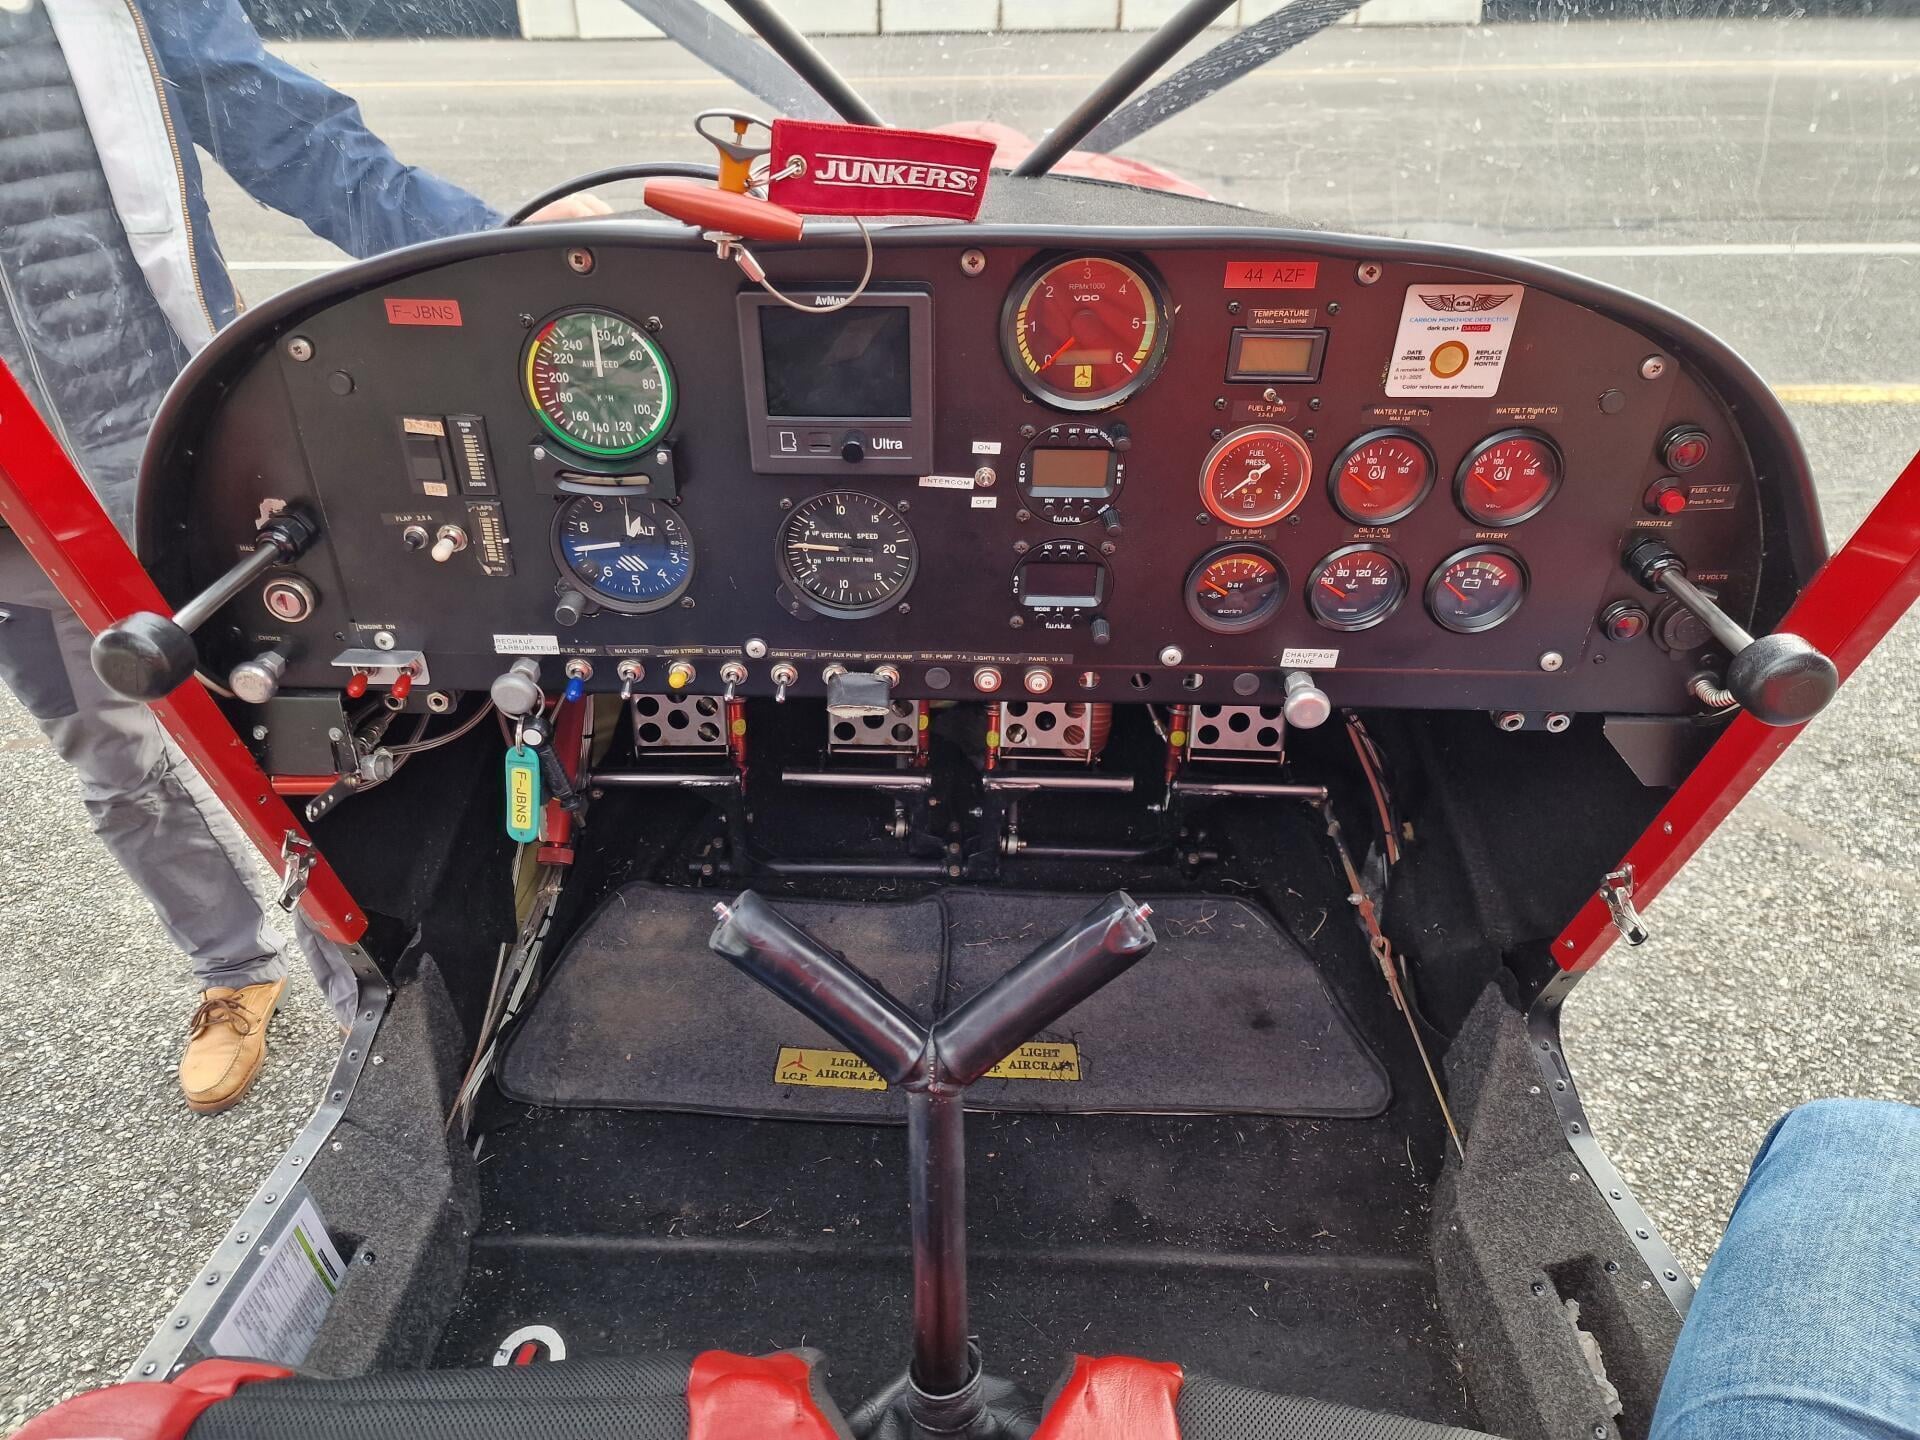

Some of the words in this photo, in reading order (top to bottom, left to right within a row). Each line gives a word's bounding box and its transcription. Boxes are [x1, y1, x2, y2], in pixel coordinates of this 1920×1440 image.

[815, 160, 968, 190] JUNKERS
[1084, 268, 1092, 279] 3
[1244, 269, 1264, 282] 44
[1272, 269, 1306, 282] AZF
[1046, 286, 1054, 298] 2
[1119, 284, 1127, 295] 4
[392, 305, 454, 319] F-JBNS
[1030, 321, 1036, 332] 1
[1132, 318, 1140, 329] 5
[597, 330, 610, 341] 30
[562, 340, 582, 351] 240
[611, 336, 625, 347] 40
[553, 354, 573, 364] 220
[630, 351, 642, 361] 60
[1115, 352, 1123, 364] 6
[582, 360, 619, 369] AIREED
[549, 373, 569, 383] 200
[642, 379, 655, 389] 80
[555, 392, 573, 403] 180
[633, 405, 650, 415] 100
[1527, 407, 1545, 415] Right
[572, 411, 590, 422] 160
[592, 423, 609, 433] 140
[615, 421, 632, 432] 120
[872, 438, 903, 449] Ultra
[925, 478, 971, 486] INTERCOM
[593, 501, 603, 512] 9
[836, 506, 845, 515] 10
[871, 515, 879, 523] 15
[579, 522, 589, 533] 8
[665, 520, 676, 530] 2
[638, 527, 655, 536] ALT
[883, 544, 896, 553] 20
[670, 553, 680, 564] 3
[603, 566, 613, 577] 6
[657, 569, 667, 578] 4
[632, 575, 641, 586] 5
[839, 580, 849, 588] 10
[515, 771, 527, 823] F-JBNS
[1020, 1048, 1060, 1057] LIGHT
